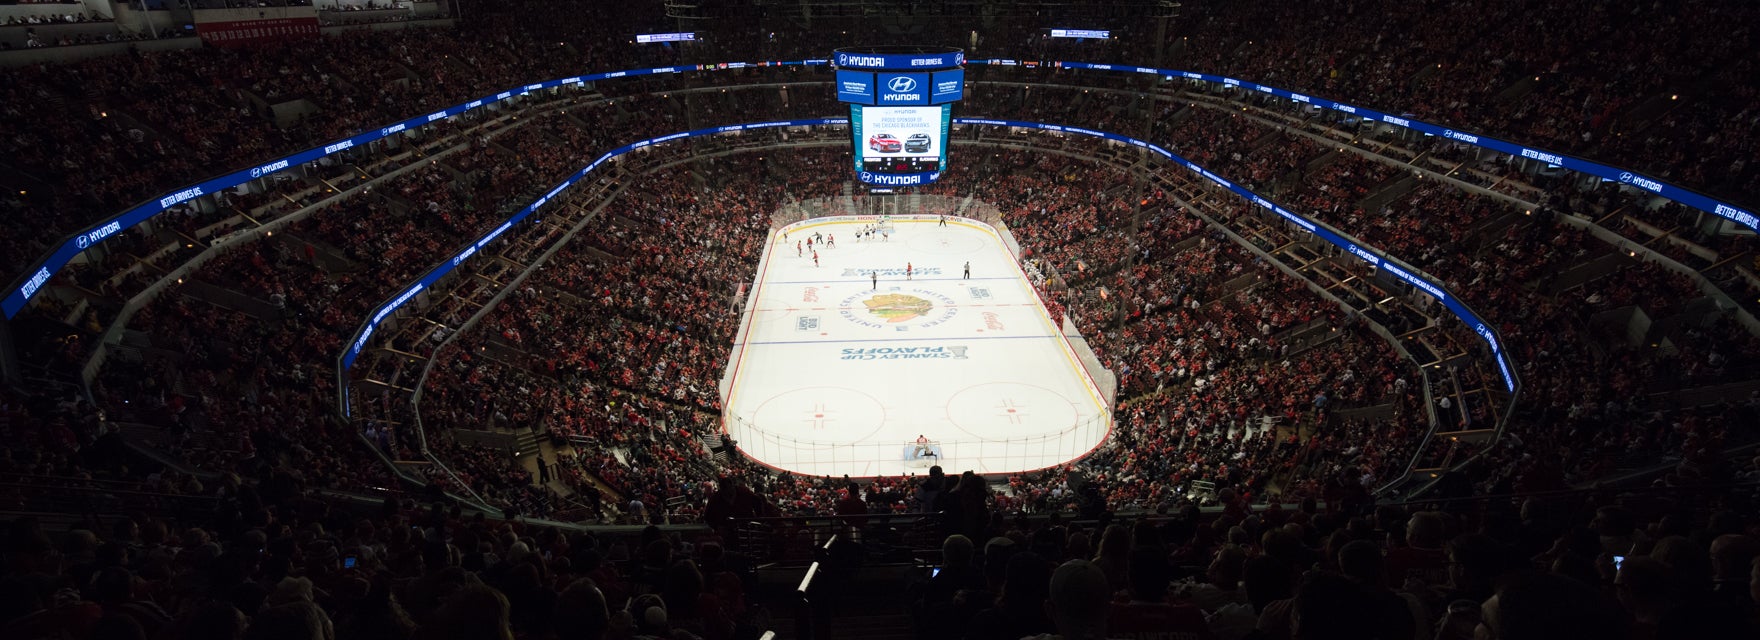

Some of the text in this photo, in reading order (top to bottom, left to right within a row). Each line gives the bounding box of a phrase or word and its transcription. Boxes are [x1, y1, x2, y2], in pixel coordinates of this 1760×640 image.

[848, 56, 884, 66] HYUNDAI
[1454, 132, 1478, 143] HYUNDAI
[1522, 149, 1538, 159] BETTER
[1538, 152, 1555, 163] DRIVES
[262, 160, 288, 174] HYUNDAI
[875, 175, 920, 184] HYUNDAI
[1632, 176, 1662, 192] HYUNDAI
[160, 195, 176, 208] BETTER
[1715, 204, 1736, 219] BETTER
[1735, 210, 1754, 226] DRIVES
[90, 221, 120, 242] HYUNDAI
[1356, 248, 1379, 265] HYUNDAI
[913, 288, 955, 304] UNITED
[799, 317, 808, 330] LIGHT
[808, 318, 817, 328] BUD
[840, 310, 882, 328] UNITED
[921, 308, 958, 328] CENTER
